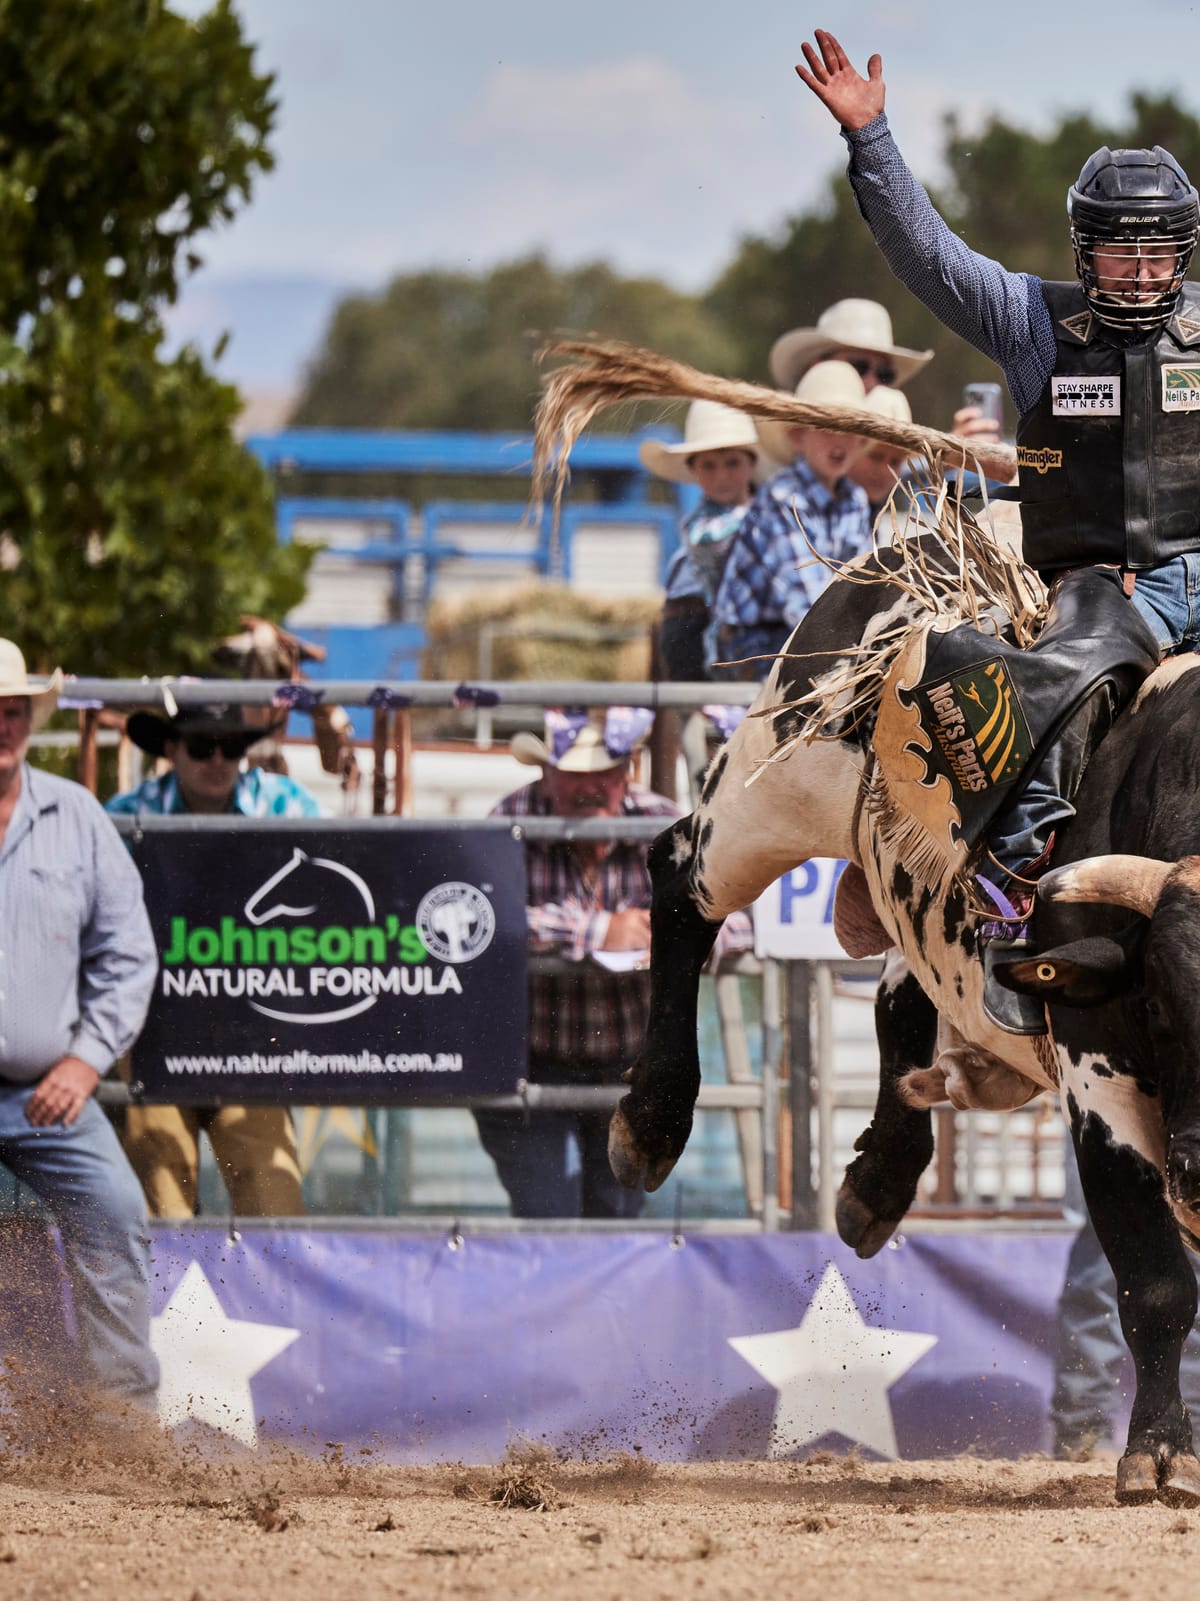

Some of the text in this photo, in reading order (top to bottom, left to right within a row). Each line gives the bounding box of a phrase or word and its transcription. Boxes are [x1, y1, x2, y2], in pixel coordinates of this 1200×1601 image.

[1057, 384, 1114, 392] STAY SHARPE
[1165, 389, 1188, 402] Neil's
[1058, 400, 1114, 408] FITNESS
[1016, 447, 1060, 470] Wrangler
[926, 681, 988, 792] Neil's Parts
[164, 914, 429, 964] Johnson's
[162, 965, 463, 997] NATURAL FORMULA
[165, 1049, 464, 1075] www.naturalformula.com.au
